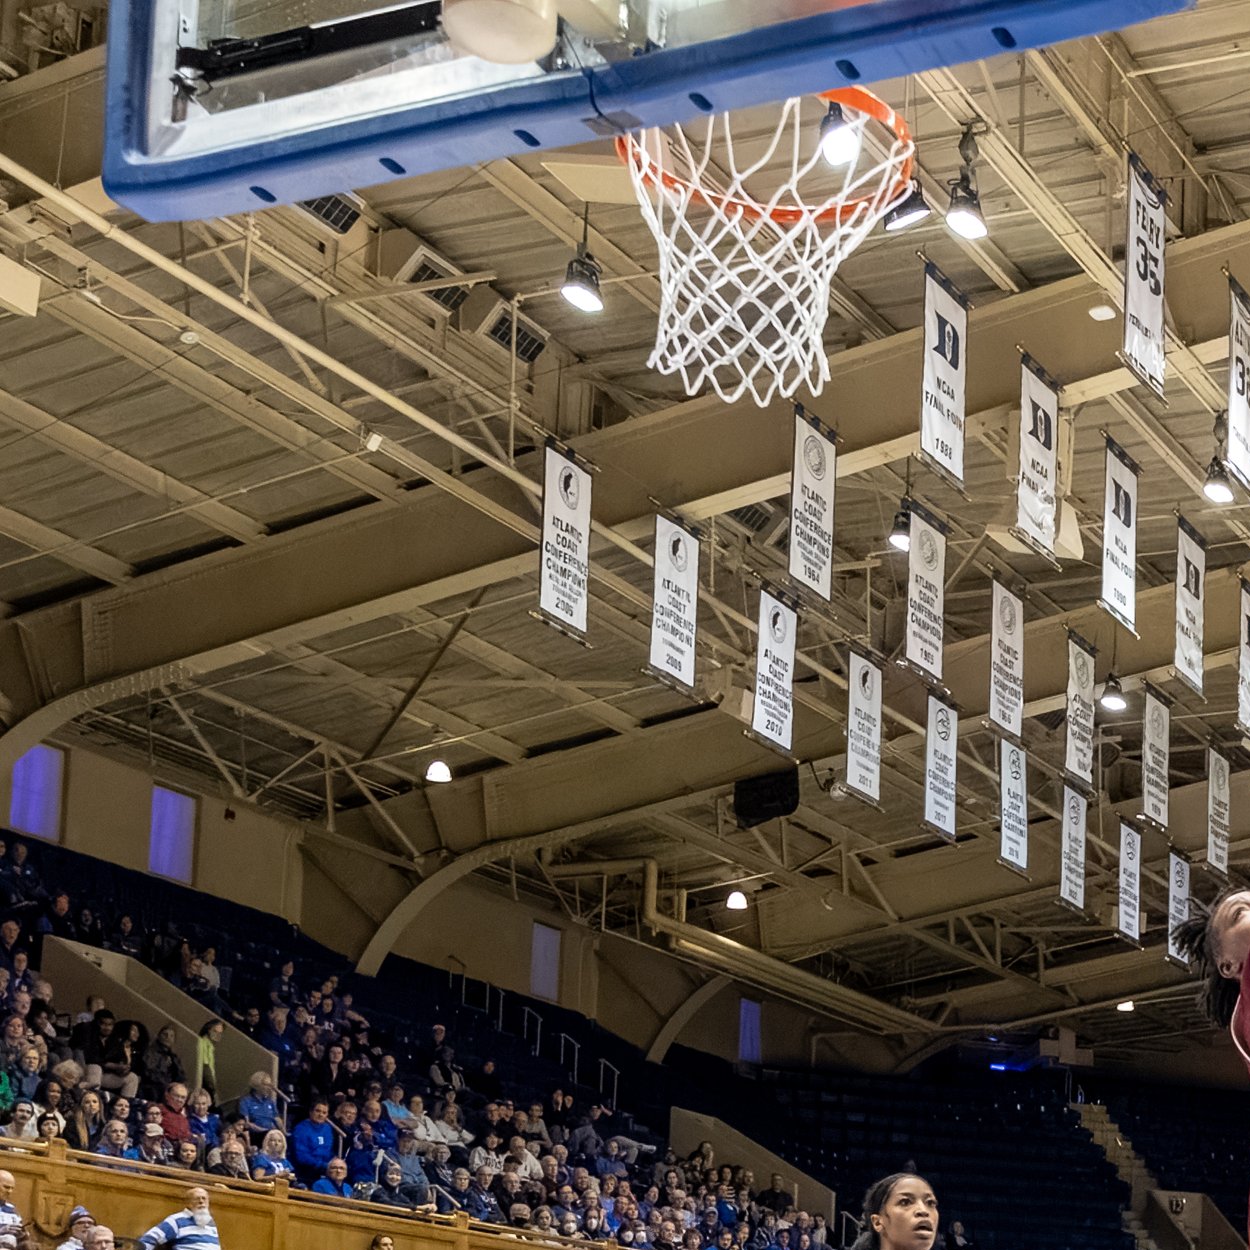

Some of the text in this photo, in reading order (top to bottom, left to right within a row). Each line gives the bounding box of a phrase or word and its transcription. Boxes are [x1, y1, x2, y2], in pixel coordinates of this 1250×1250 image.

[1136, 236, 1162, 297] 35
[936, 377, 955, 402] NCAA
[1031, 458, 1049, 481] NCAA
[552, 515, 583, 544] ATLANTIC
[556, 533, 578, 556] COAST
[545, 541, 588, 578] CONFERENCE
[546, 557, 586, 591] CHAMPIONS
